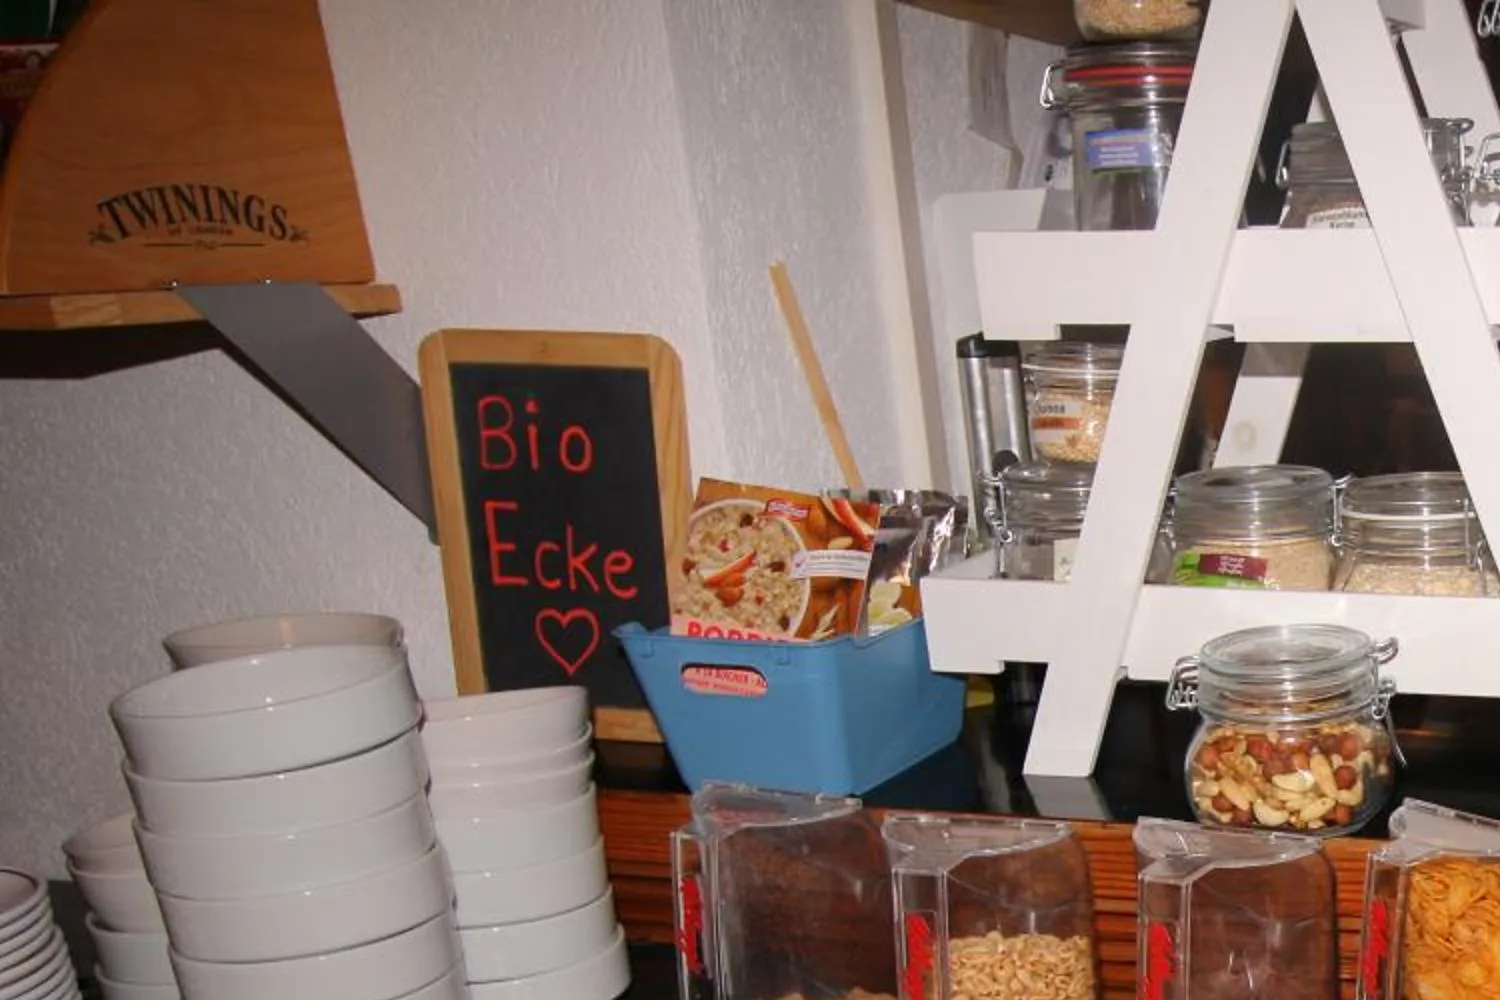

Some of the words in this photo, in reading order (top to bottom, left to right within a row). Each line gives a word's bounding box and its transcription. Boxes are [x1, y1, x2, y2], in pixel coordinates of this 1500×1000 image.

[97, 183, 288, 241] TWININGS
[476, 394, 594, 473] Bio
[484, 500, 640, 600] Ecke
